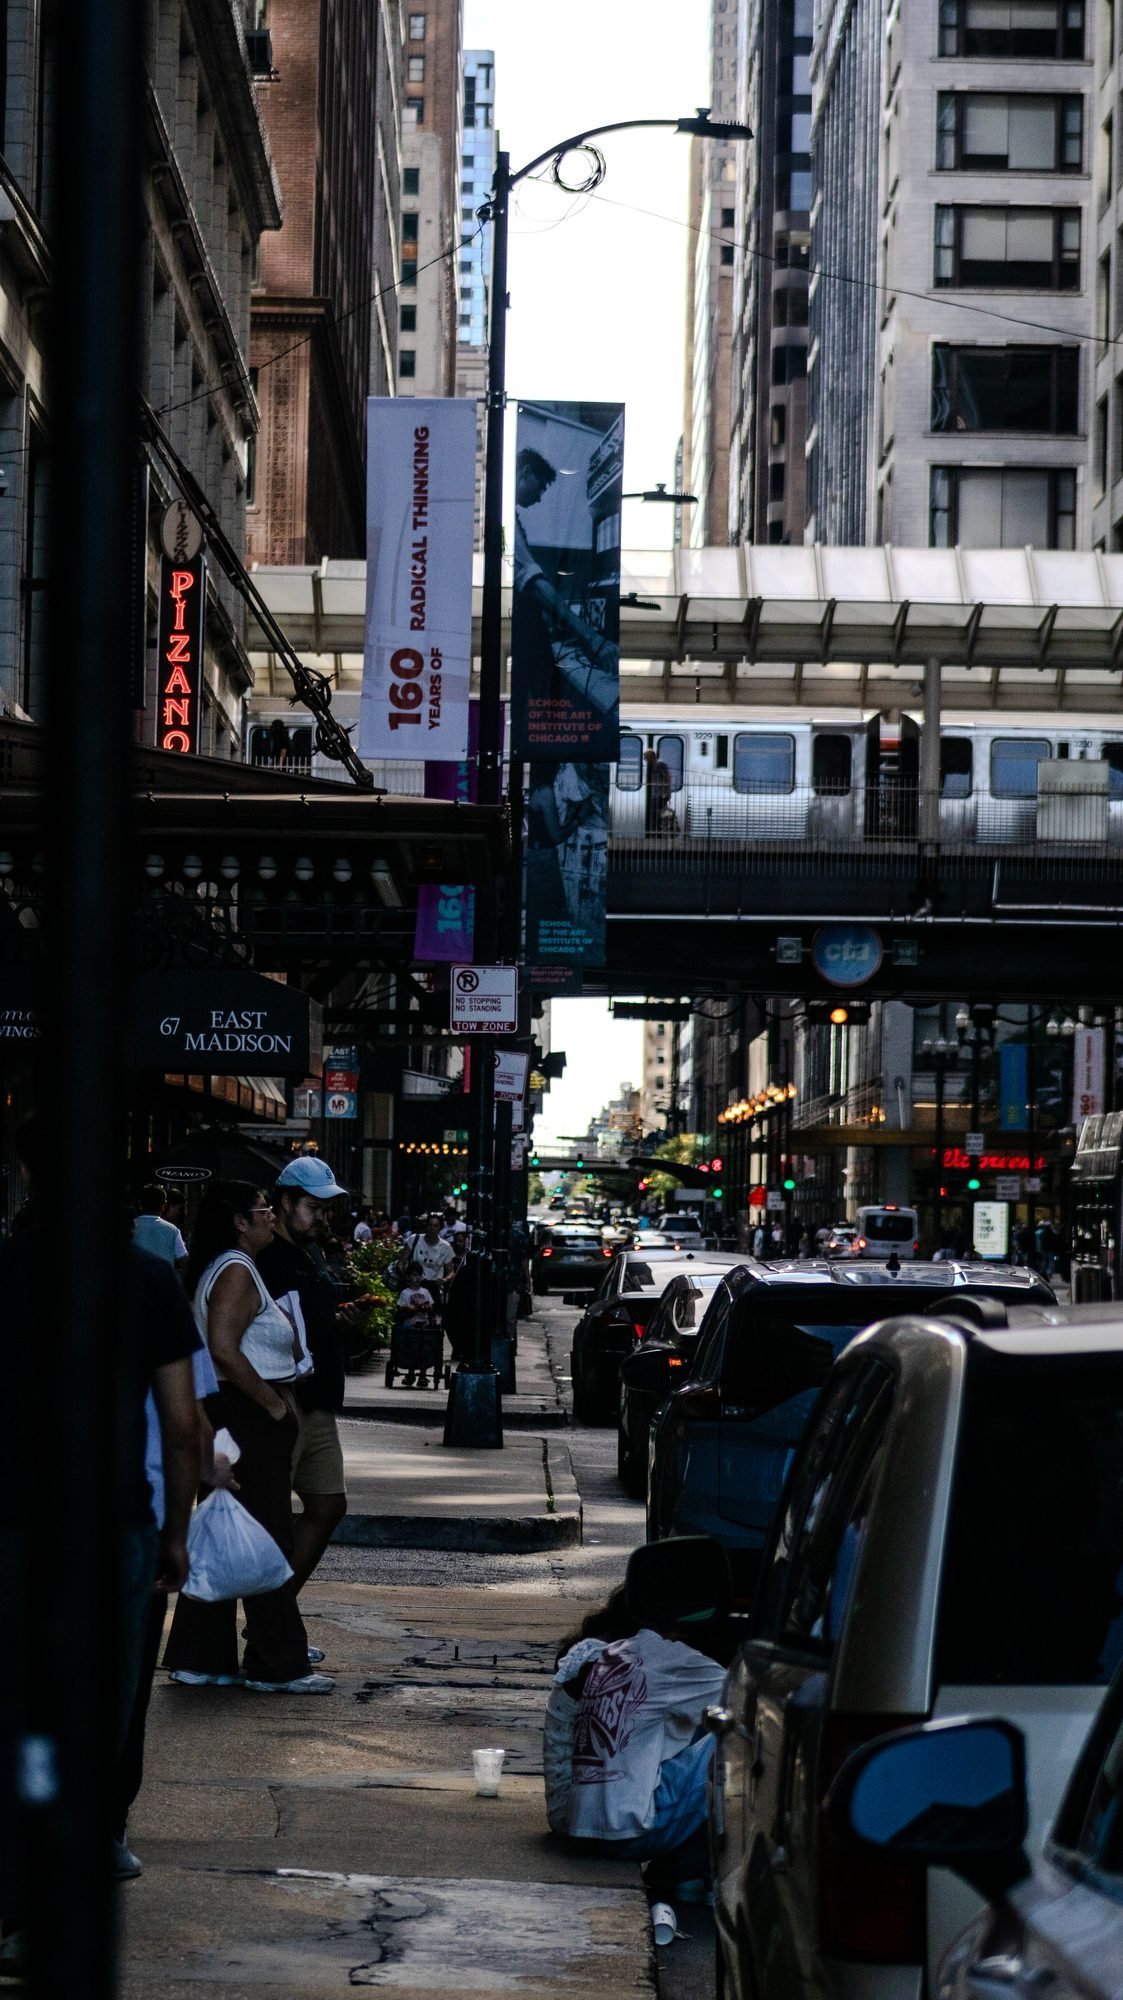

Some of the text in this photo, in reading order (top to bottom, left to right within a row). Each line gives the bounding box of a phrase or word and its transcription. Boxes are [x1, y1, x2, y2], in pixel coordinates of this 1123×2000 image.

[173, 502, 191, 561] PIZZA
[410, 425, 430, 631] RADICAL THINKING
[163, 571, 194, 752] PIZANO
[388, 648, 425, 731] 160
[428, 646, 443, 730] YEARS OF
[528, 699, 574, 708] SCHOOL
[528, 711, 592, 719] OF THE ART
[528, 722, 602, 731] INSTITUTE OF
[528, 734, 579, 743] CHICAGO
[539, 920, 572, 928] SCHOOL
[823, 939, 871, 961] cta
[469, 997, 501, 1005] STOPPING
[159, 1017, 181, 1036] 67
[210, 1010, 267, 1029] EAST
[455, 1022, 511, 1031] TOW ZONE
[185, 1033, 292, 1053] MADISON
